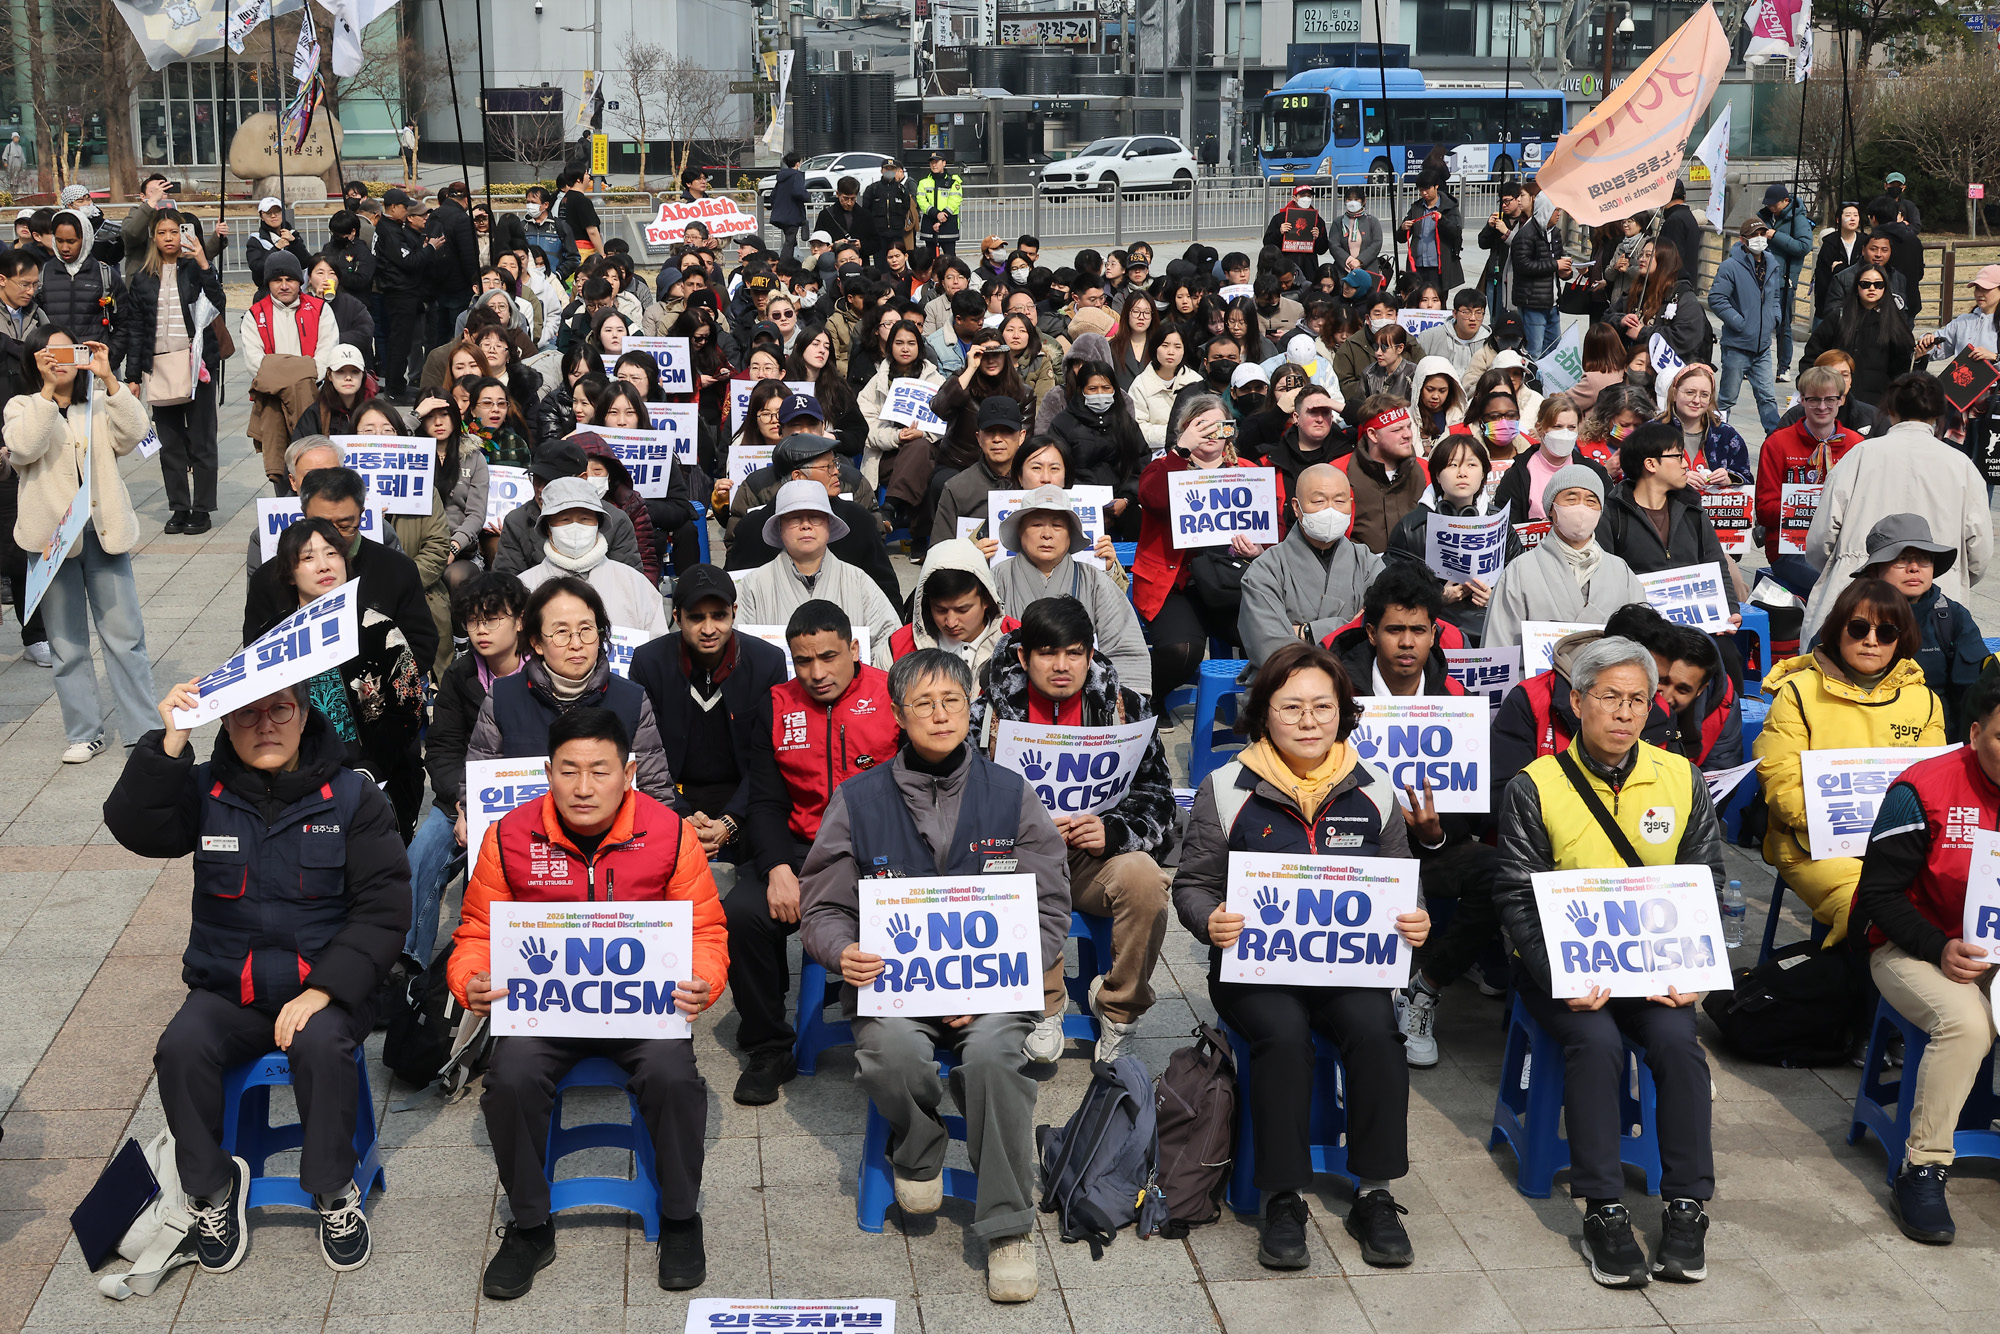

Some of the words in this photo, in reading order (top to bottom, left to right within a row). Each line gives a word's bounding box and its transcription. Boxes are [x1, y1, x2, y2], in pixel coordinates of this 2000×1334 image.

[1304, 20, 1359, 32] 2176-6023
[1283, 96, 1308, 109] 260
[1498, 131, 1511, 143] 20
[661, 198, 738, 222] Abolish
[646, 226, 685, 242] Forc
[708, 217, 758, 235] Labor!
[608, 443, 668, 461] 종차별
[1209, 486, 1253, 510] NO
[1179, 510, 1270, 535] RACISM
[1645, 579, 1719, 607] 종차별
[1447, 664, 1510, 688] 차별
[1388, 725, 1453, 758] NO
[1890, 723, 1923, 742] 정의당
[1055, 751, 1120, 783] NO
[1374, 762, 1478, 792] CISM
[1035, 770, 1132, 812] ACISM
[1946, 806, 1980, 825] 단결
[312, 824, 340, 834] 민주노총
[1643, 821, 1671, 834] 정의당
[531, 860, 569, 879] 투쟁
[1258, 871, 1271, 879] the
[1272, 871, 1313, 880] Elimination
[1314, 873, 1322, 881] of
[1323, 873, 1346, 881] Racial
[1347, 874, 1400, 883] Discrimination
[1281, 863, 1299, 871] 2026
[1299, 864, 1348, 873] International
[1349, 866, 1364, 875] Day
[909, 888, 926, 896] 2026
[926, 886, 971, 895] International
[972, 886, 986, 895] Day
[1563, 886, 1576, 894] the
[1576, 885, 1614, 893] Elimination
[1623, 884, 1646, 892] Racial
[1583, 877, 1599, 885] 2026
[1600, 876, 1646, 884] International
[888, 897, 900, 905] the
[901, 896, 940, 905] Elimination
[940, 895, 949, 903] of
[949, 895, 970, 903] Racial
[971, 893, 1020, 902] Discrimination
[1295, 888, 1372, 927] NO
[566, 912, 618, 920] International
[619, 912, 634, 921] Day
[617, 920, 673, 928] Discrimination
[1603, 897, 1678, 937] NO
[927, 910, 999, 952] NO
[565, 937, 646, 976] NO
[1237, 927, 1399, 966] RACISM
[1560, 934, 1716, 974] RACISM
[873, 951, 1029, 993] RACISM
[506, 977, 677, 1015] RACISM
[708, 1312, 883, 1328] 인종차별
